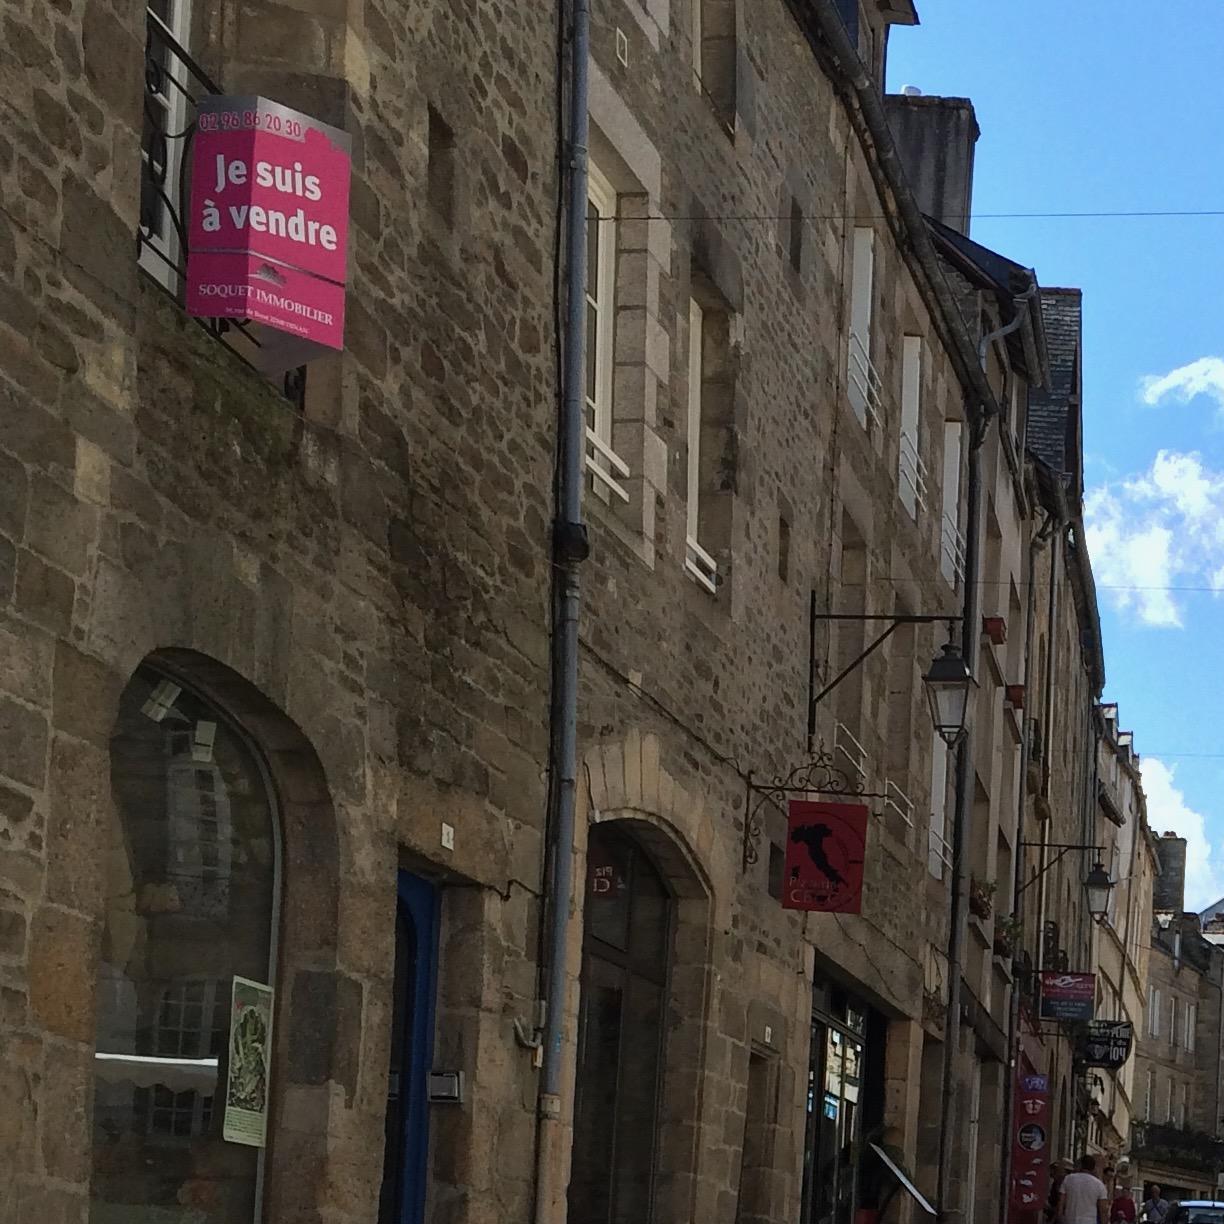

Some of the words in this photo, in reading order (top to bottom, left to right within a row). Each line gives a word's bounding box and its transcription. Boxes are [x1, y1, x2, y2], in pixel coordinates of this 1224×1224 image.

[200, 114, 218, 131] 02
[222, 111, 239, 128] 96
[245, 111, 260, 127] 86
[265, 113, 281, 132] 20
[286, 119, 301, 137] 30
[215, 154, 247, 193] Je
[256, 162, 322, 201] suis
[202, 199, 221, 231] à
[229, 205, 337, 250] vendre
[199, 283, 254, 298] SOQUET
[256, 288, 333, 326] IMMOBILIER
